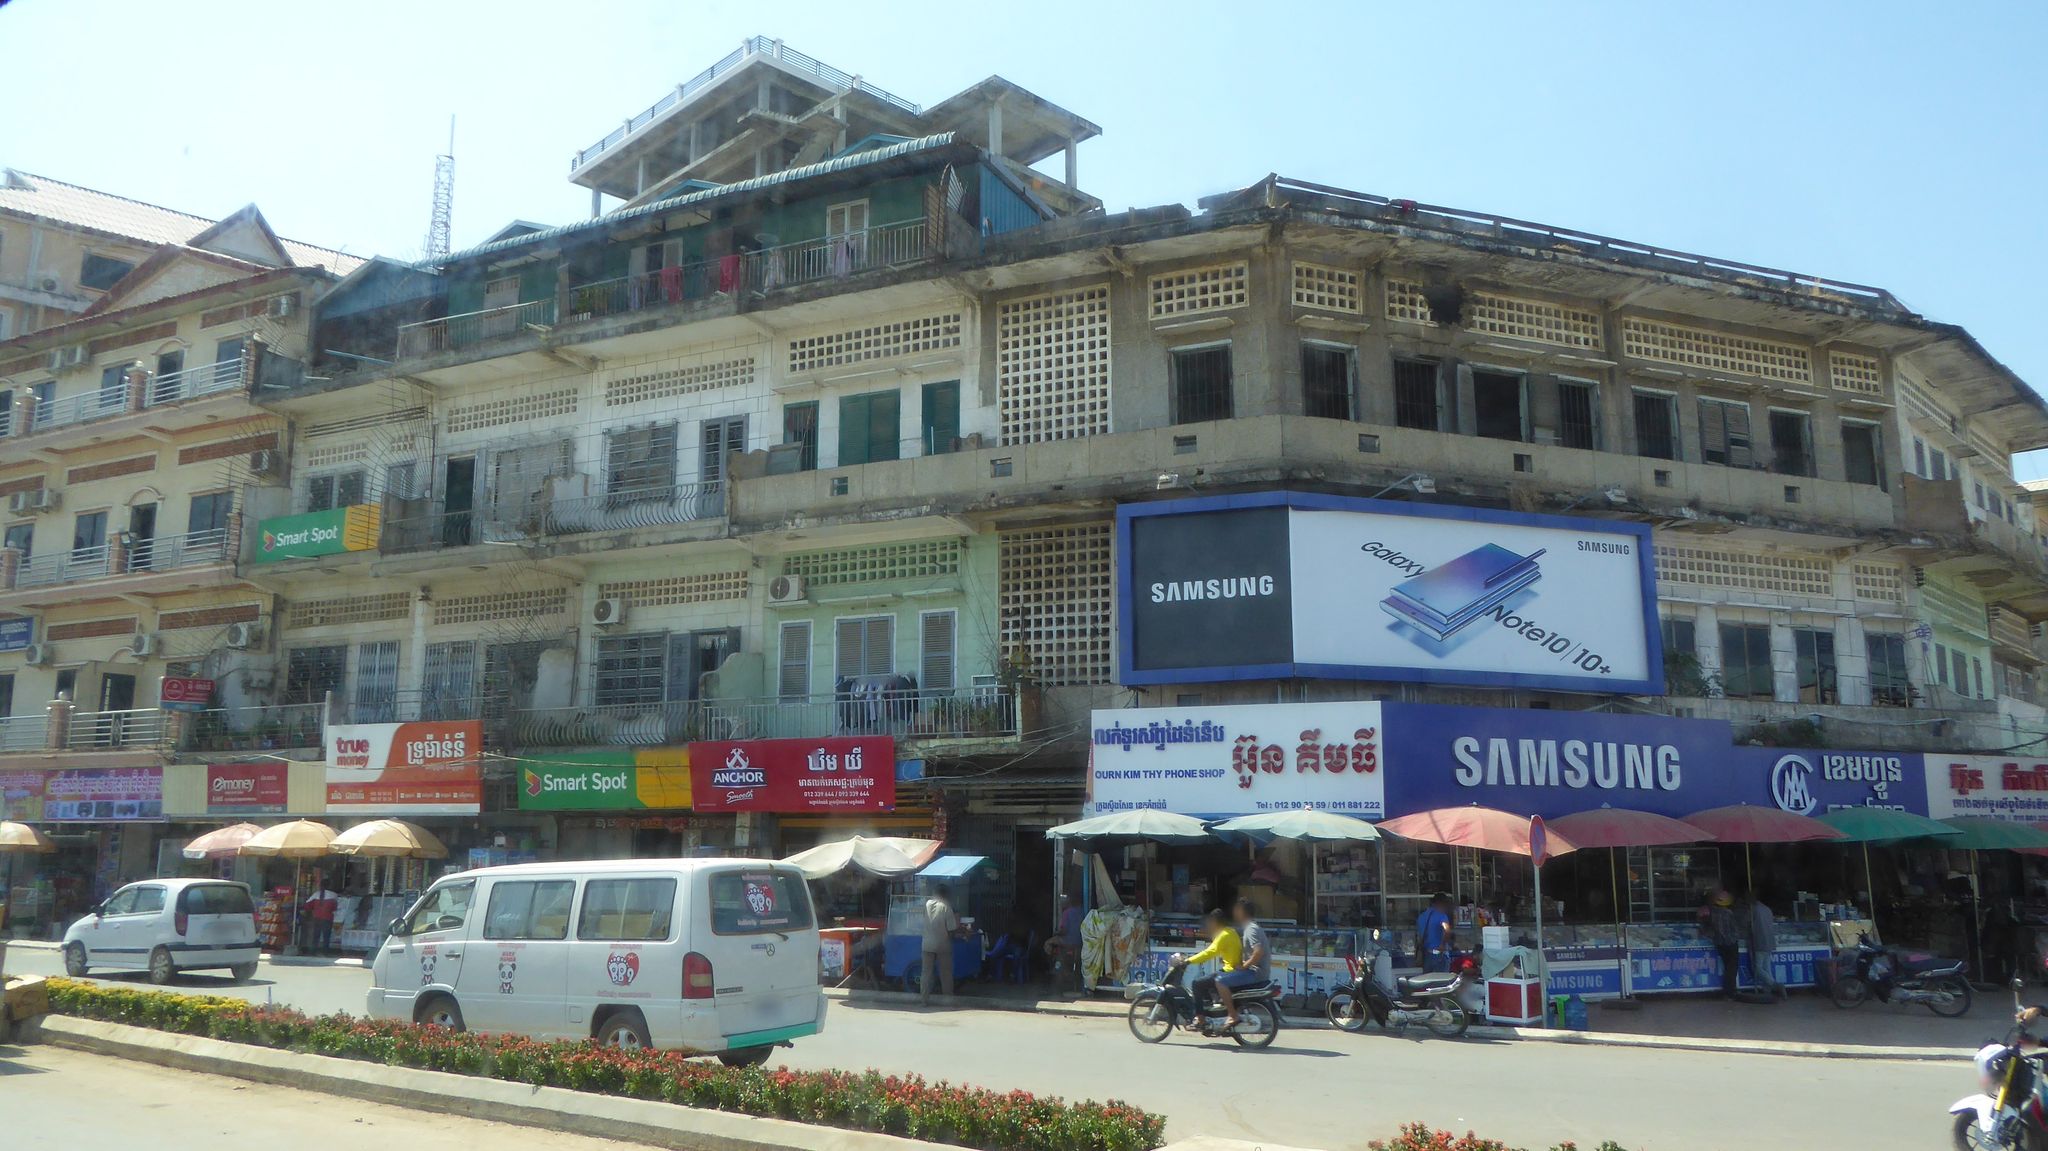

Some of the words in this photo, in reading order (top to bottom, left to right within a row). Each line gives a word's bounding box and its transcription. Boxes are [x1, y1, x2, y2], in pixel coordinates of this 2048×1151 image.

[277, 529, 309, 547] Smart
[311, 525, 338, 544] Spot
[1577, 540, 1630, 555] SAMSUNG
[1360, 541, 1425, 578] Galaxy
[1151, 575, 1274, 603] SAMSUNG
[336, 737, 370, 754] true
[336, 755, 369, 768] money
[1453, 736, 1681, 791] SAMSUNG
[713, 772, 764, 783] ANCHOR
[1095, 770, 1121, 779] OURN
[1123, 770, 1140, 779] KIM
[1143, 769, 1162, 779] THY
[1165, 769, 1197, 778] PHONE
[1199, 768, 1225, 778] SHOP
[543, 773, 587, 791] Smart
[592, 771, 627, 793] Spot
[726, 789, 754, 803] Smooth
[1274, 801, 1288, 809] 012
[1291, 801, 1300, 809] 90
[1364, 801, 1380, 809] 222
[1556, 951, 1586, 960] SAMSUNG
[1548, 975, 1603, 990] AMSUNG
